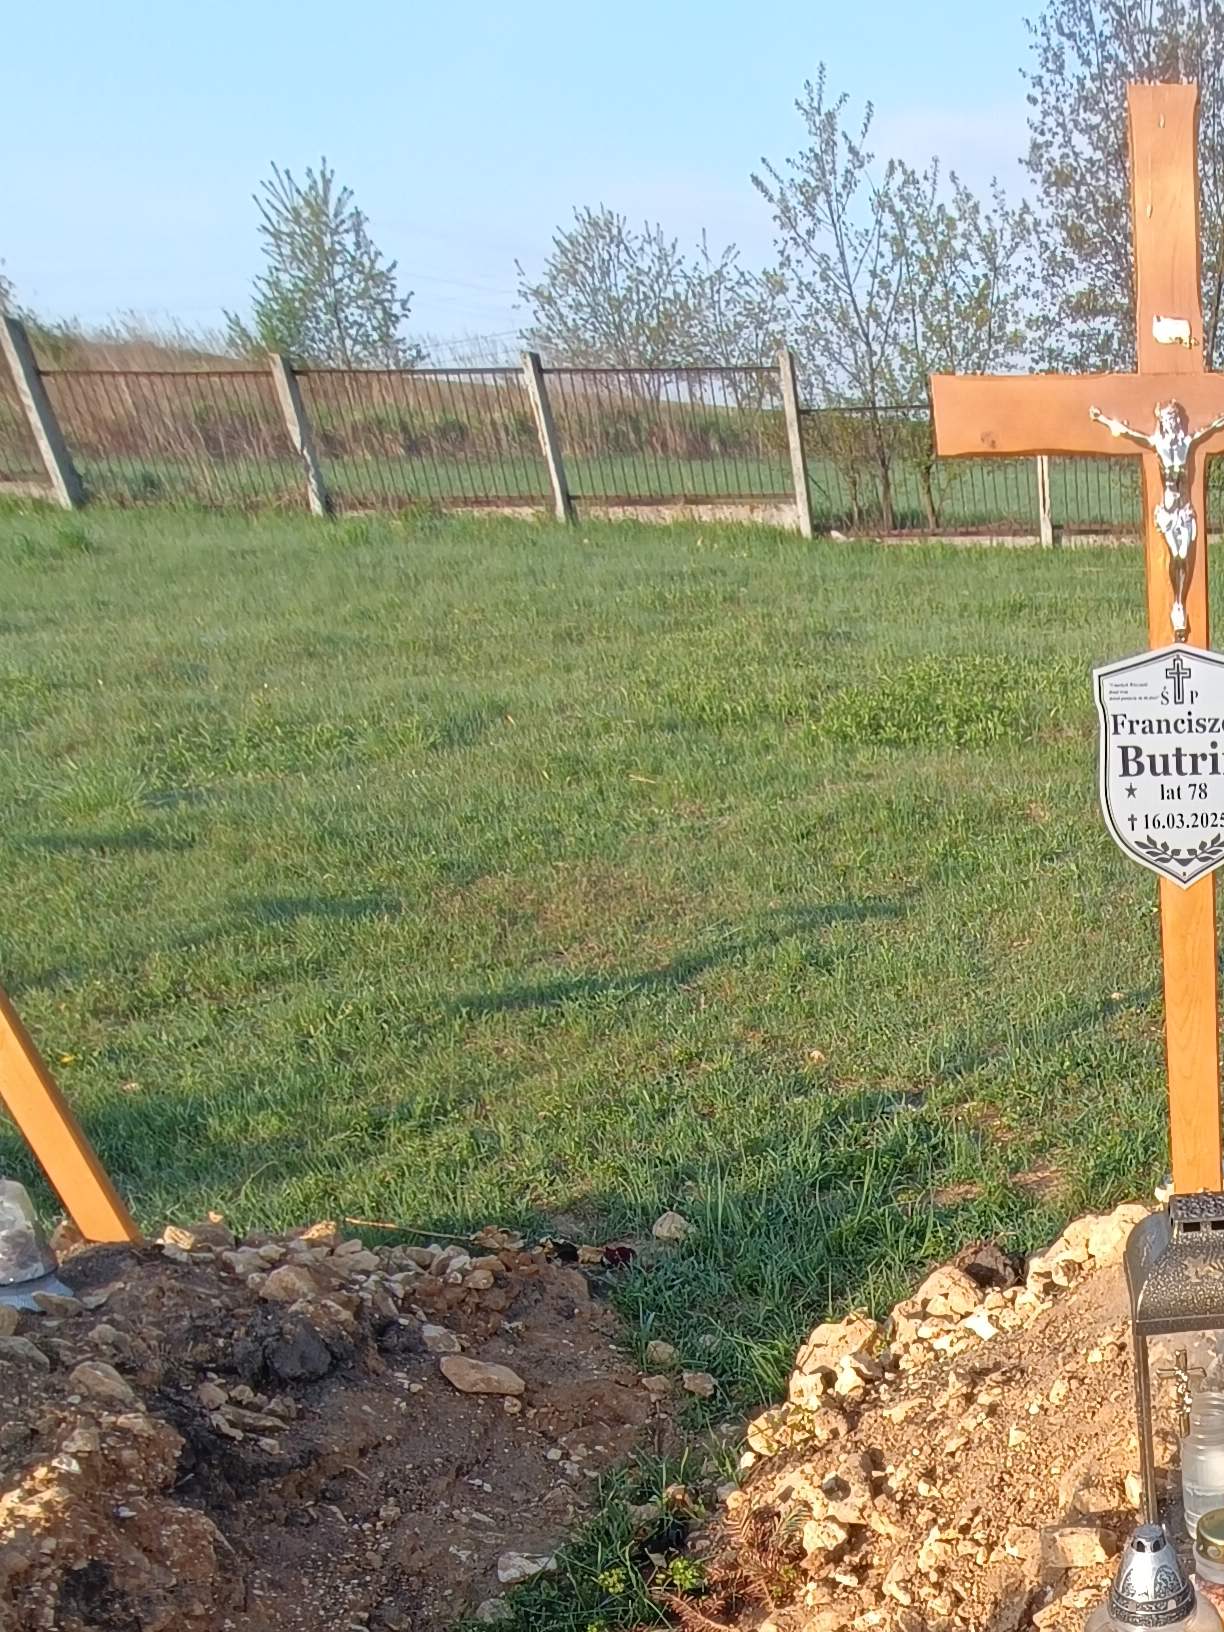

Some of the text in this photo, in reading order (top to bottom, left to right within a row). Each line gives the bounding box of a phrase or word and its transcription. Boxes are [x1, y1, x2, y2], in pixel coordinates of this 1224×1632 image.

[1160, 686, 1199, 705] Ś P
[1160, 783, 1208, 801] lat 78
